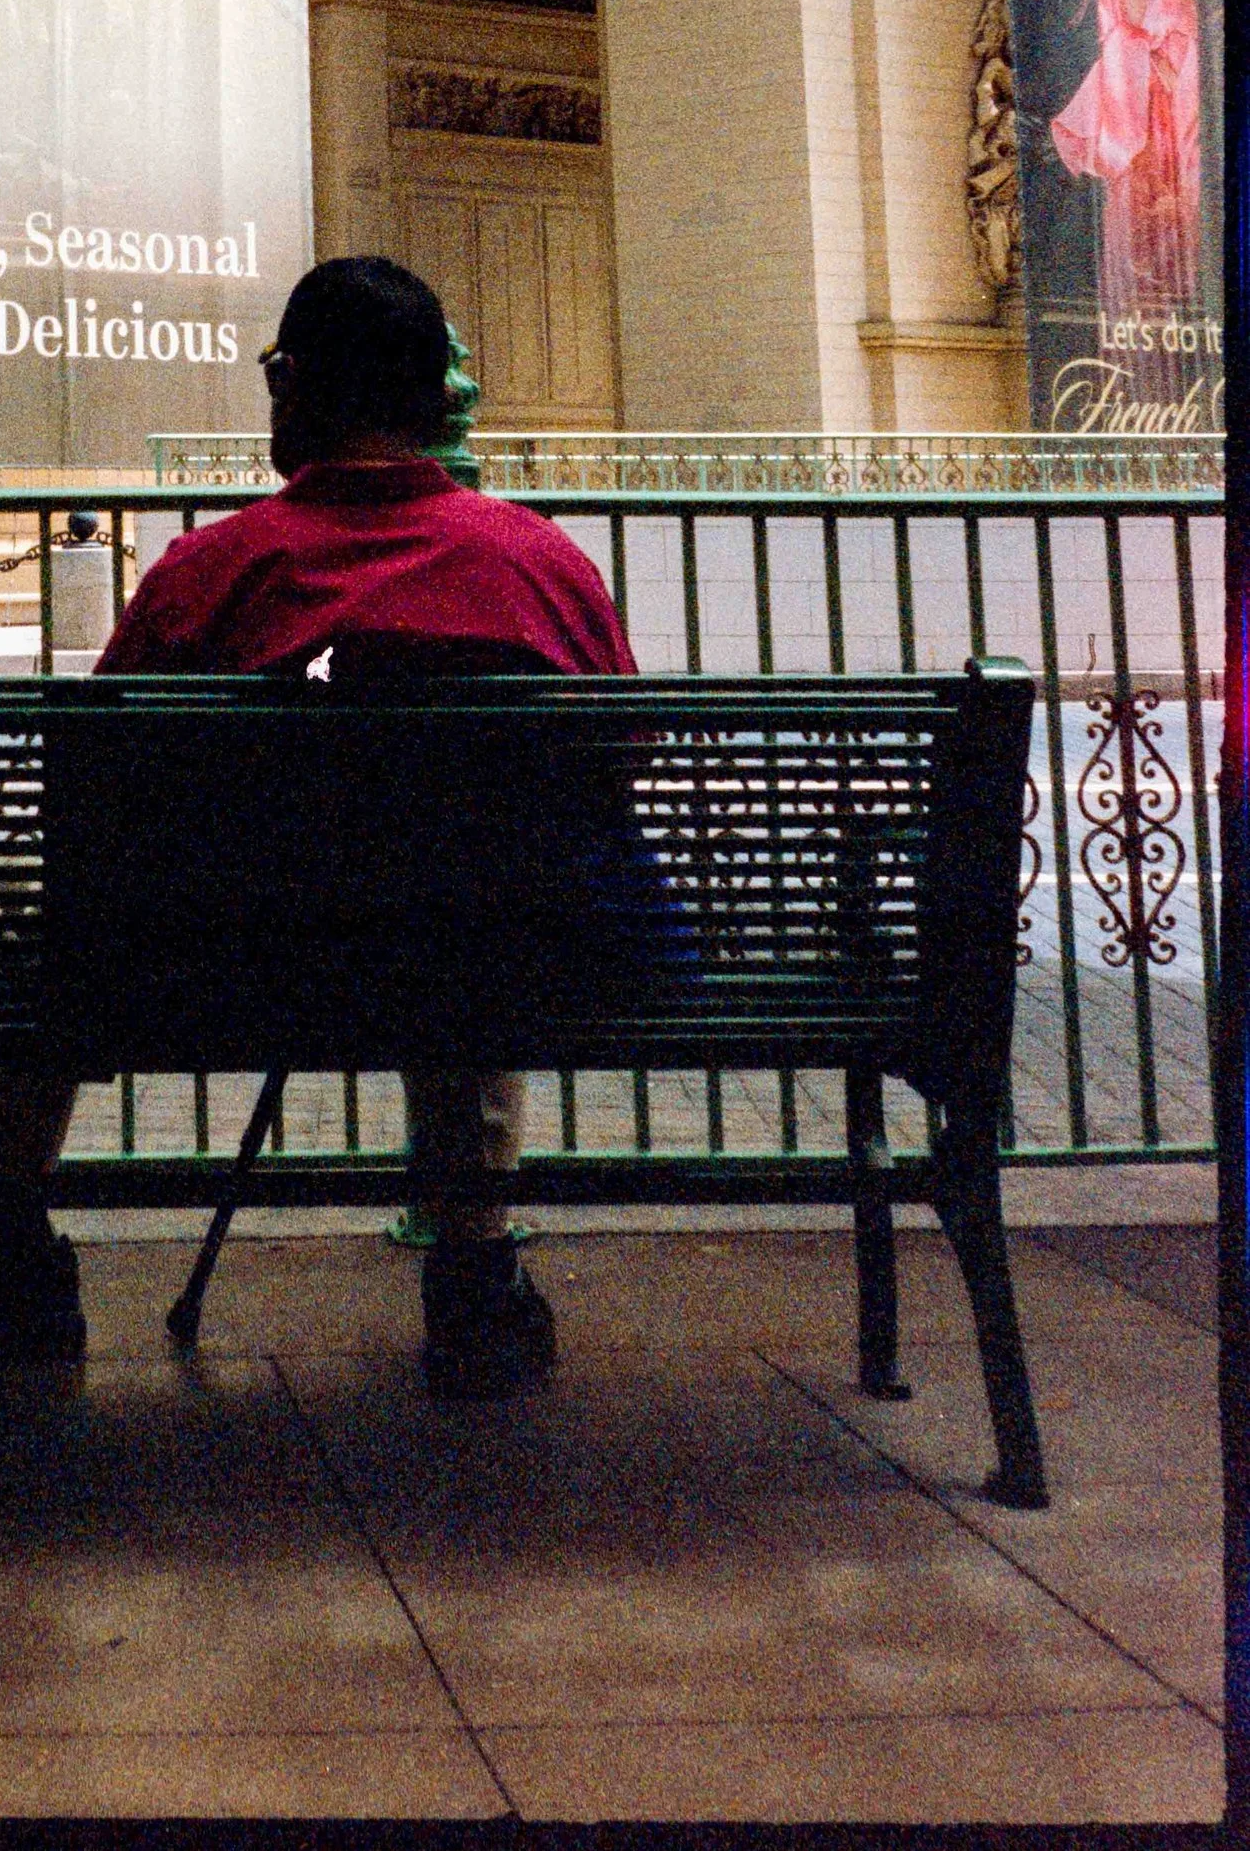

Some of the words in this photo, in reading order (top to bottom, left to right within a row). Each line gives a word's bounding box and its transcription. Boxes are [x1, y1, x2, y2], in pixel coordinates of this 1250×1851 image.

[24, 211, 261, 279] Seasonal
[1100, 309, 1154, 351] Let's
[1162, 310, 1199, 353] do
